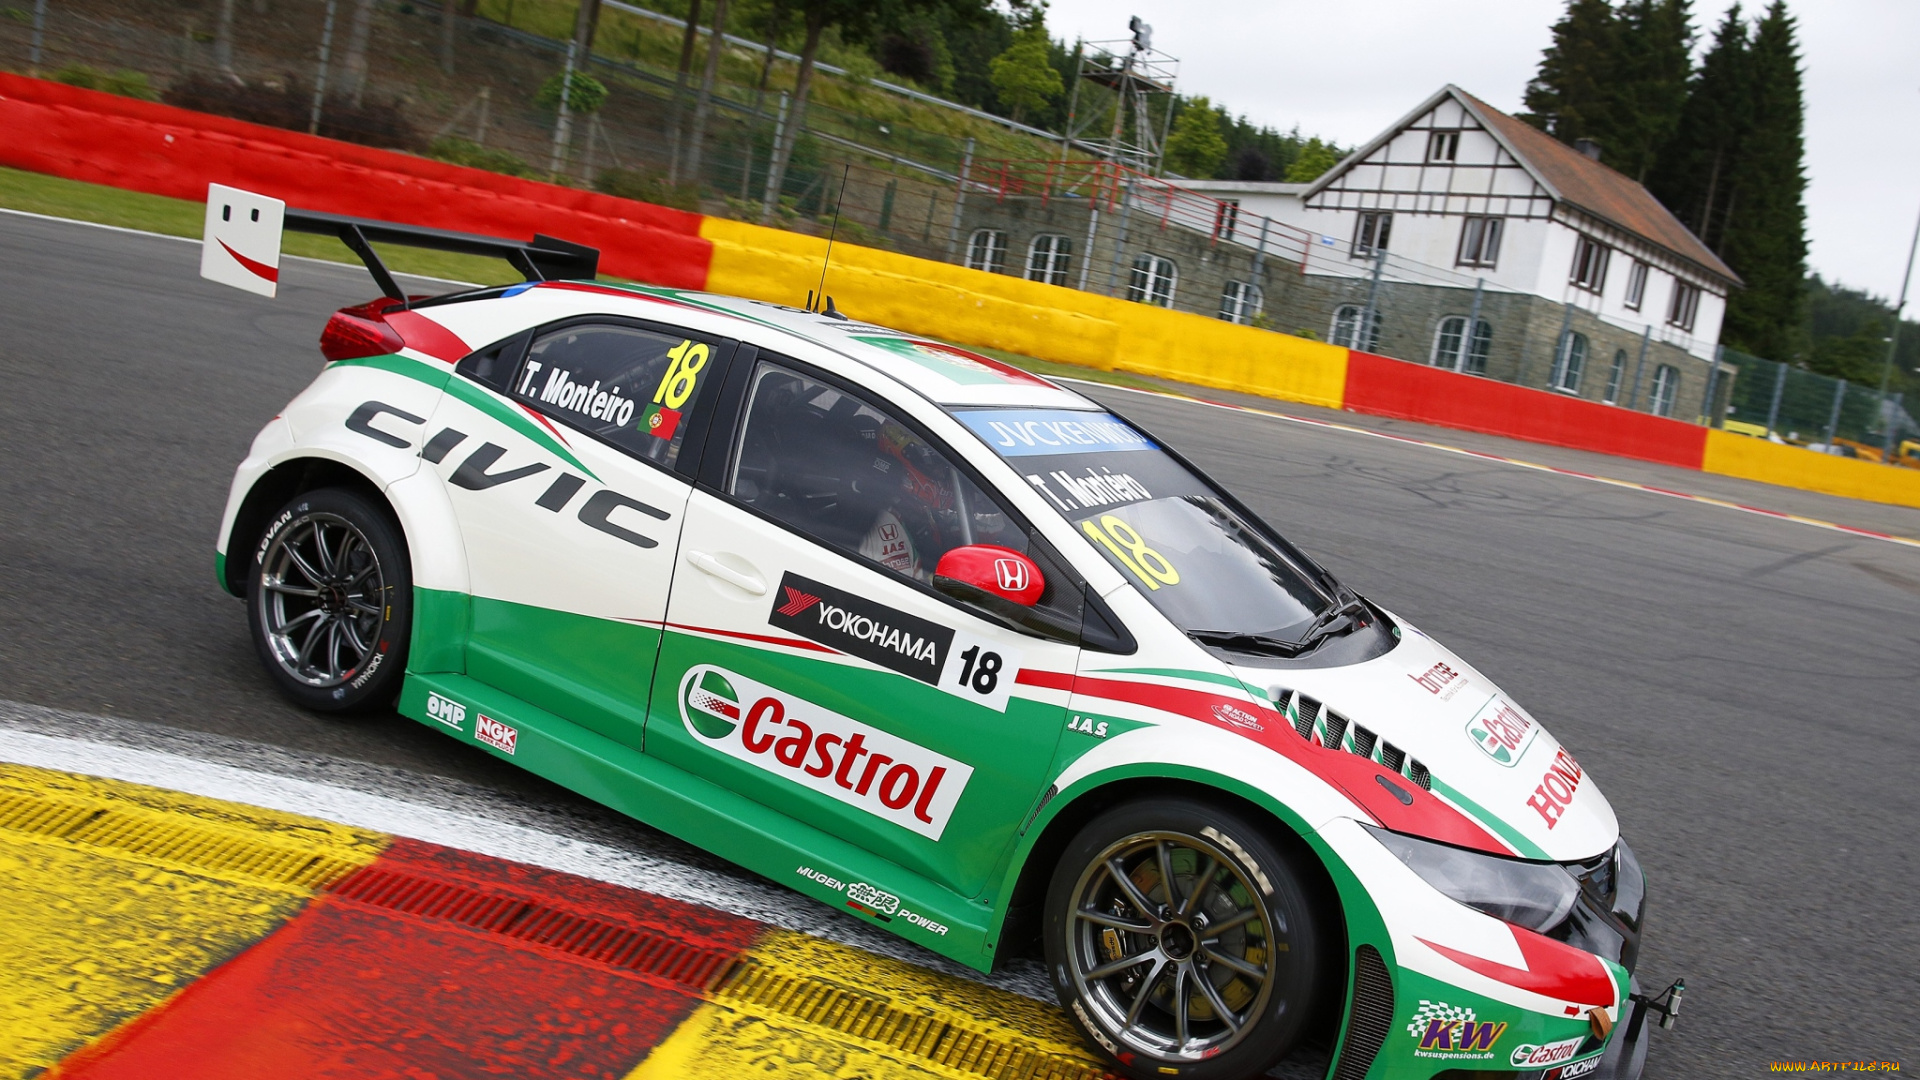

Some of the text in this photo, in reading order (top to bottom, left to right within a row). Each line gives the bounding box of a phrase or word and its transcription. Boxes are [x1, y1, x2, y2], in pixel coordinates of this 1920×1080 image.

[653, 339, 710, 409] 18
[519, 360, 635, 427] T. Monteiro
[346, 401, 671, 549] CIVIC
[1026, 466, 1153, 512] T. Monteiro
[257, 510, 292, 565] ADVAN
[1081, 515, 1180, 591] 18
[818, 601, 936, 666] YOKOHAMA
[351, 653, 384, 689] YOKOHAMA
[958, 645, 1003, 695] 18
[1407, 662, 1459, 694] brose
[427, 695, 466, 725] OMP
[1231, 708, 1258, 723] ACTION
[1482, 700, 1531, 750] Castrol
[476, 733, 514, 754] SPARK PLUGS
[478, 716, 516, 747] NGK
[741, 696, 948, 826] Castrol
[796, 866, 846, 892] MUGEN
[897, 909, 949, 936] POWER
[1418, 1018, 1508, 1051] KW
[1414, 1049, 1494, 1060] kwsuspensions.de
[1528, 1040, 1579, 1064] Castrol
[1559, 1055, 1602, 1080] YOKOHAM
